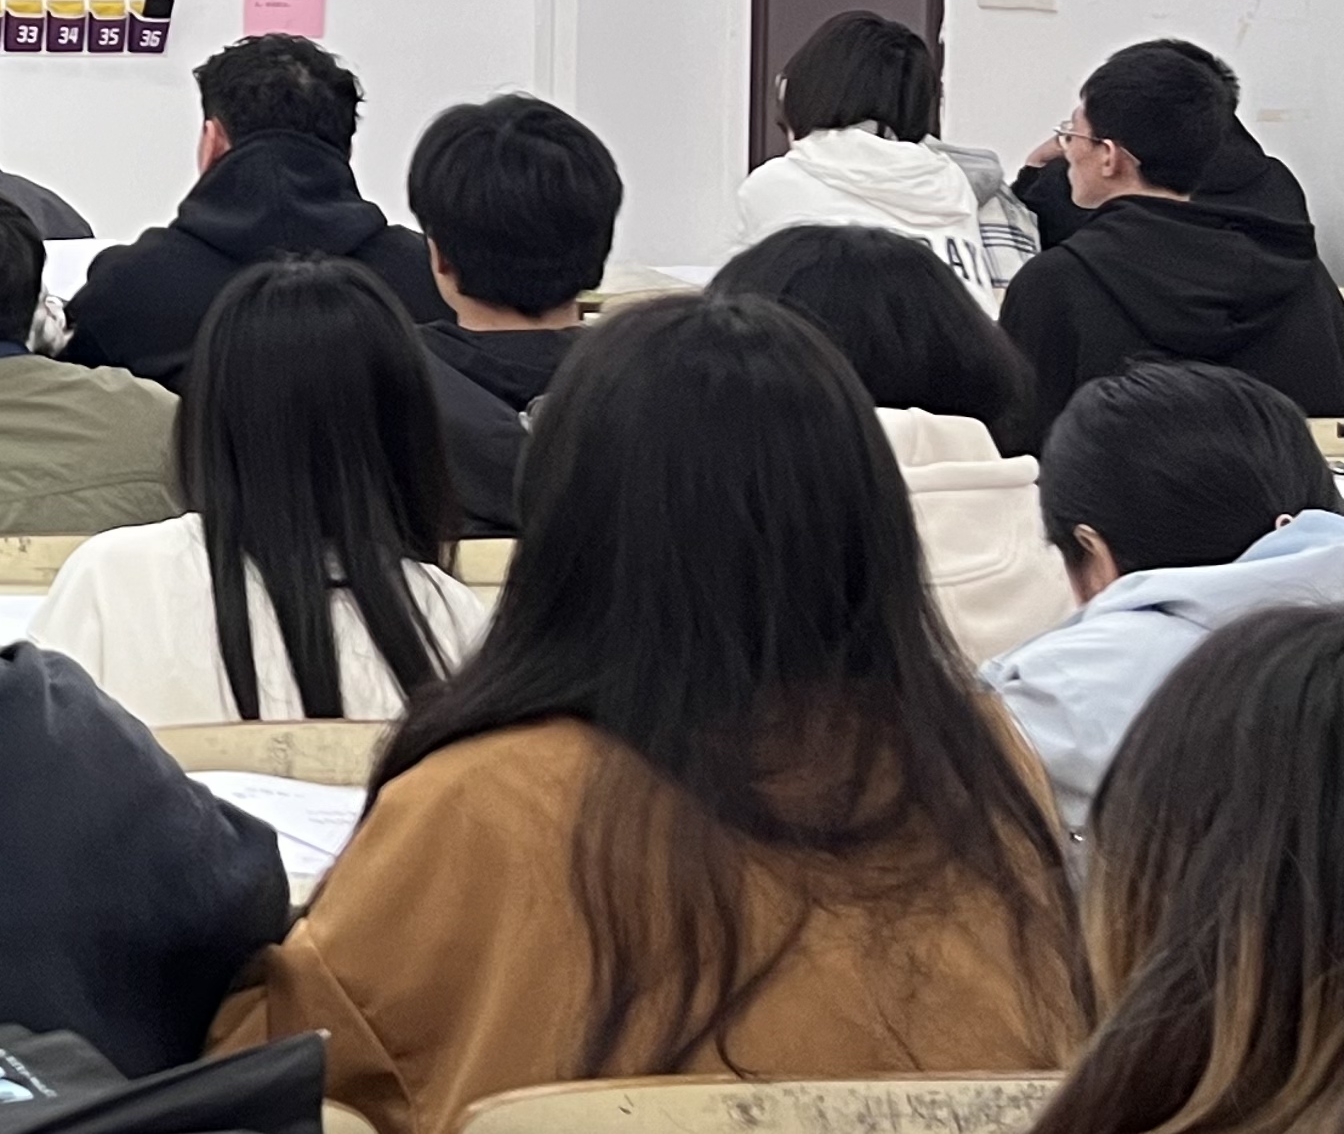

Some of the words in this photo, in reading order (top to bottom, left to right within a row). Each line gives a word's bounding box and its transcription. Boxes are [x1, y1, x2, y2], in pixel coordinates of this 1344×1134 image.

[17, 26, 38, 43] 33
[58, 27, 78, 44] 34
[99, 29, 119, 45] 35
[140, 30, 161, 46] 36
